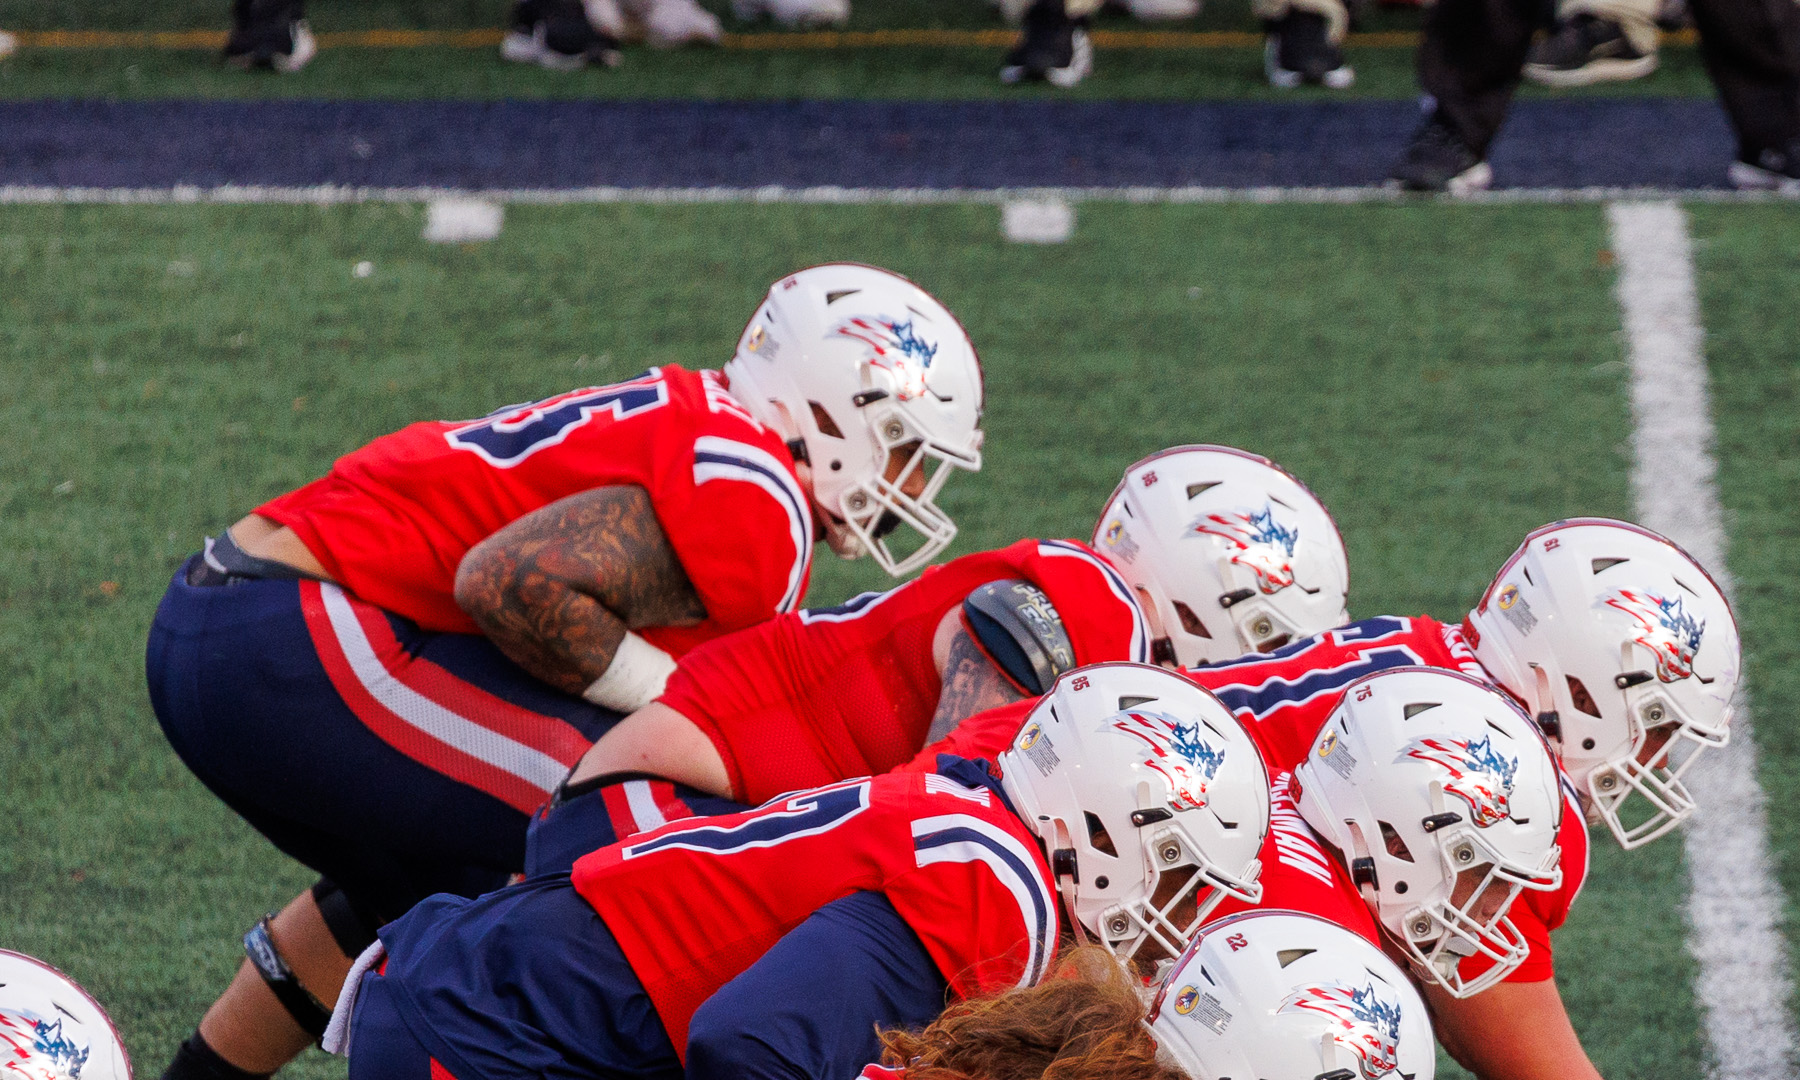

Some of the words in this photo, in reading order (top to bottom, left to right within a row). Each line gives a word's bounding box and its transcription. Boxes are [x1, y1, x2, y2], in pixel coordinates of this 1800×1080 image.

[444, 366, 670, 469] 5
[1543, 537, 1561, 552] 61
[1071, 675, 1091, 692] 85
[1355, 684, 1373, 702] 75
[1225, 932, 1249, 953] 22
